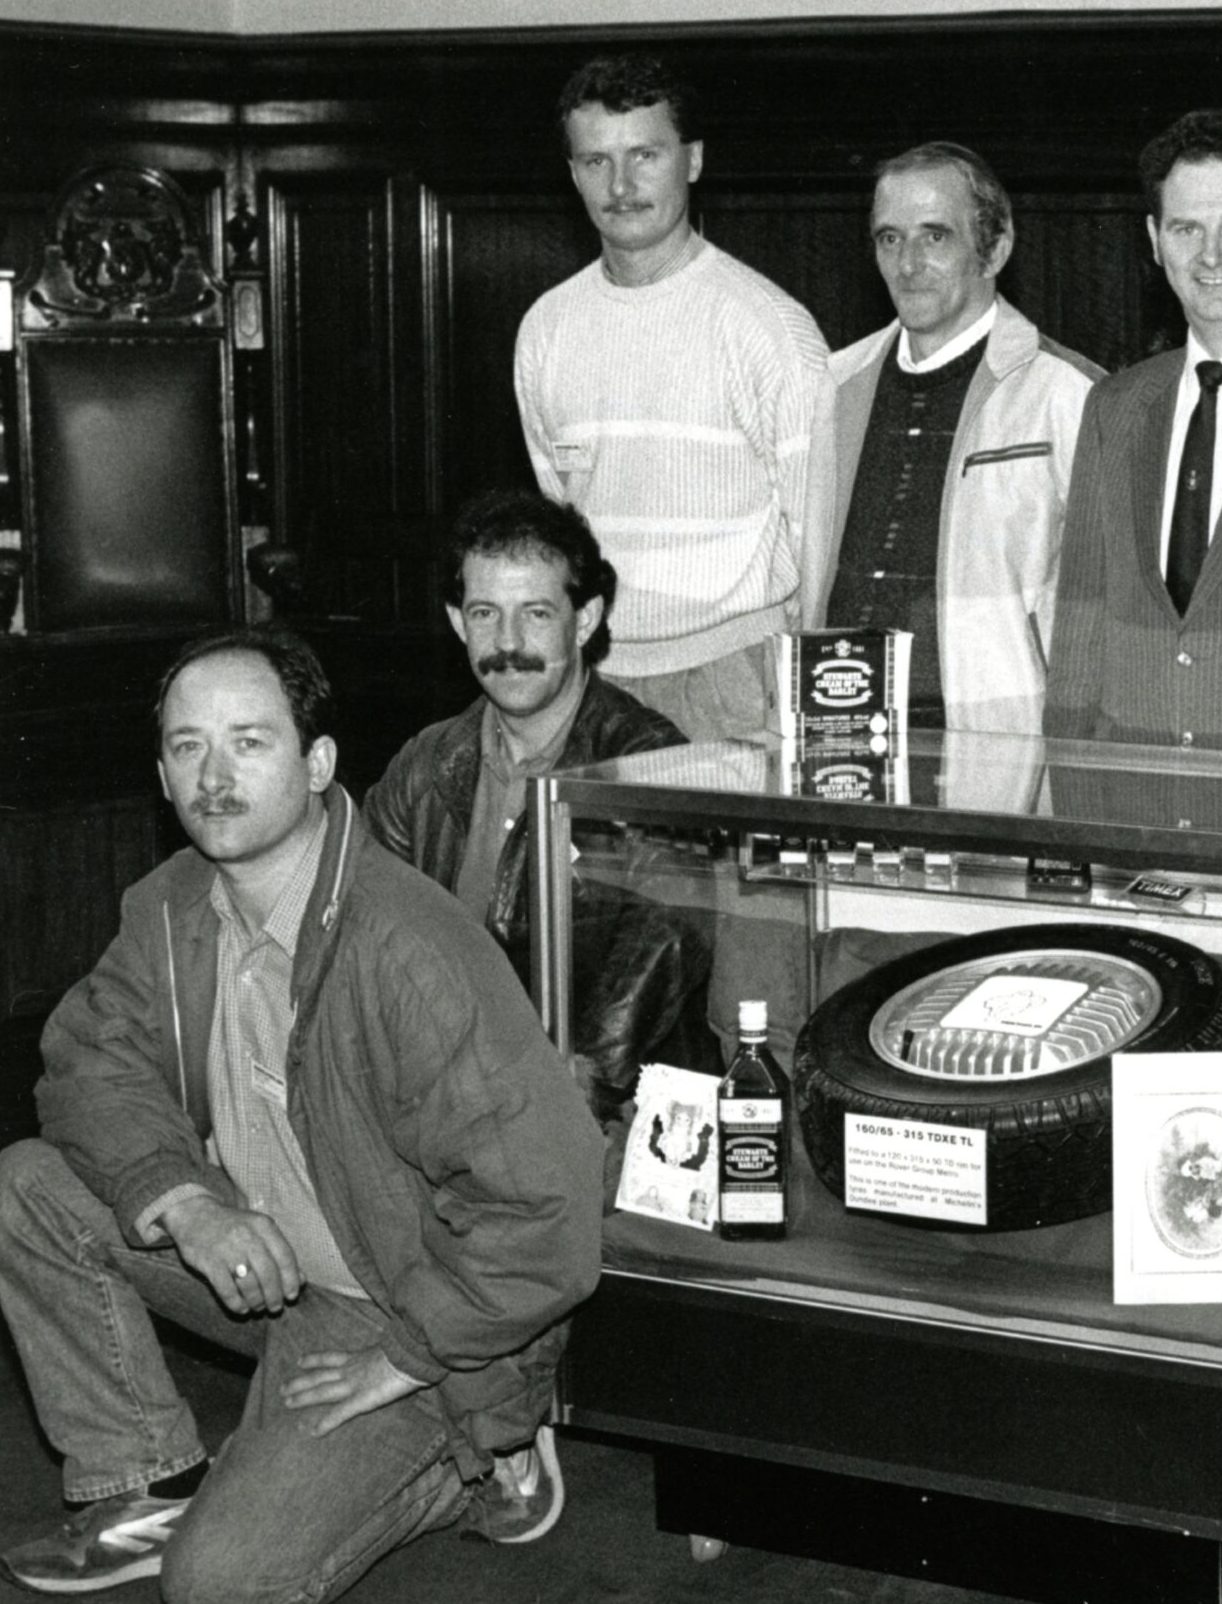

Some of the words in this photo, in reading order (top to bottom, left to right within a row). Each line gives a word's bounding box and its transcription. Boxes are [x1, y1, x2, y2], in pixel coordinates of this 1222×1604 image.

[1137, 880, 1184, 897] TIMEX
[855, 1123, 893, 1136] 160/65
[903, 1129, 923, 1140] 315
[927, 1132, 956, 1144] TDXE
[960, 1136, 973, 1146] TL
[848, 1146, 869, 1156] Fitted
[871, 1149, 878, 1157] to
[849, 1157, 861, 1165] use
[875, 1159, 886, 1168] the
[888, 1161, 909, 1171] Rover
[912, 1164, 934, 1175] Group
[849, 1174, 863, 1183] This
[866, 1177, 871, 1185] is
[874, 1179, 886, 1187] one
[889, 1180, 896, 1188] of
[898, 1181, 909, 1190] the
[912, 1183, 939, 1194] modern
[941, 1187, 981, 1200] production
[849, 1185, 866, 1195] tyres
[874, 1188, 923, 1202] manufactured
[930, 1196, 937, 1204] at
[944, 1197, 981, 1209] Michelin's
[849, 1194, 876, 1205] Dundee
